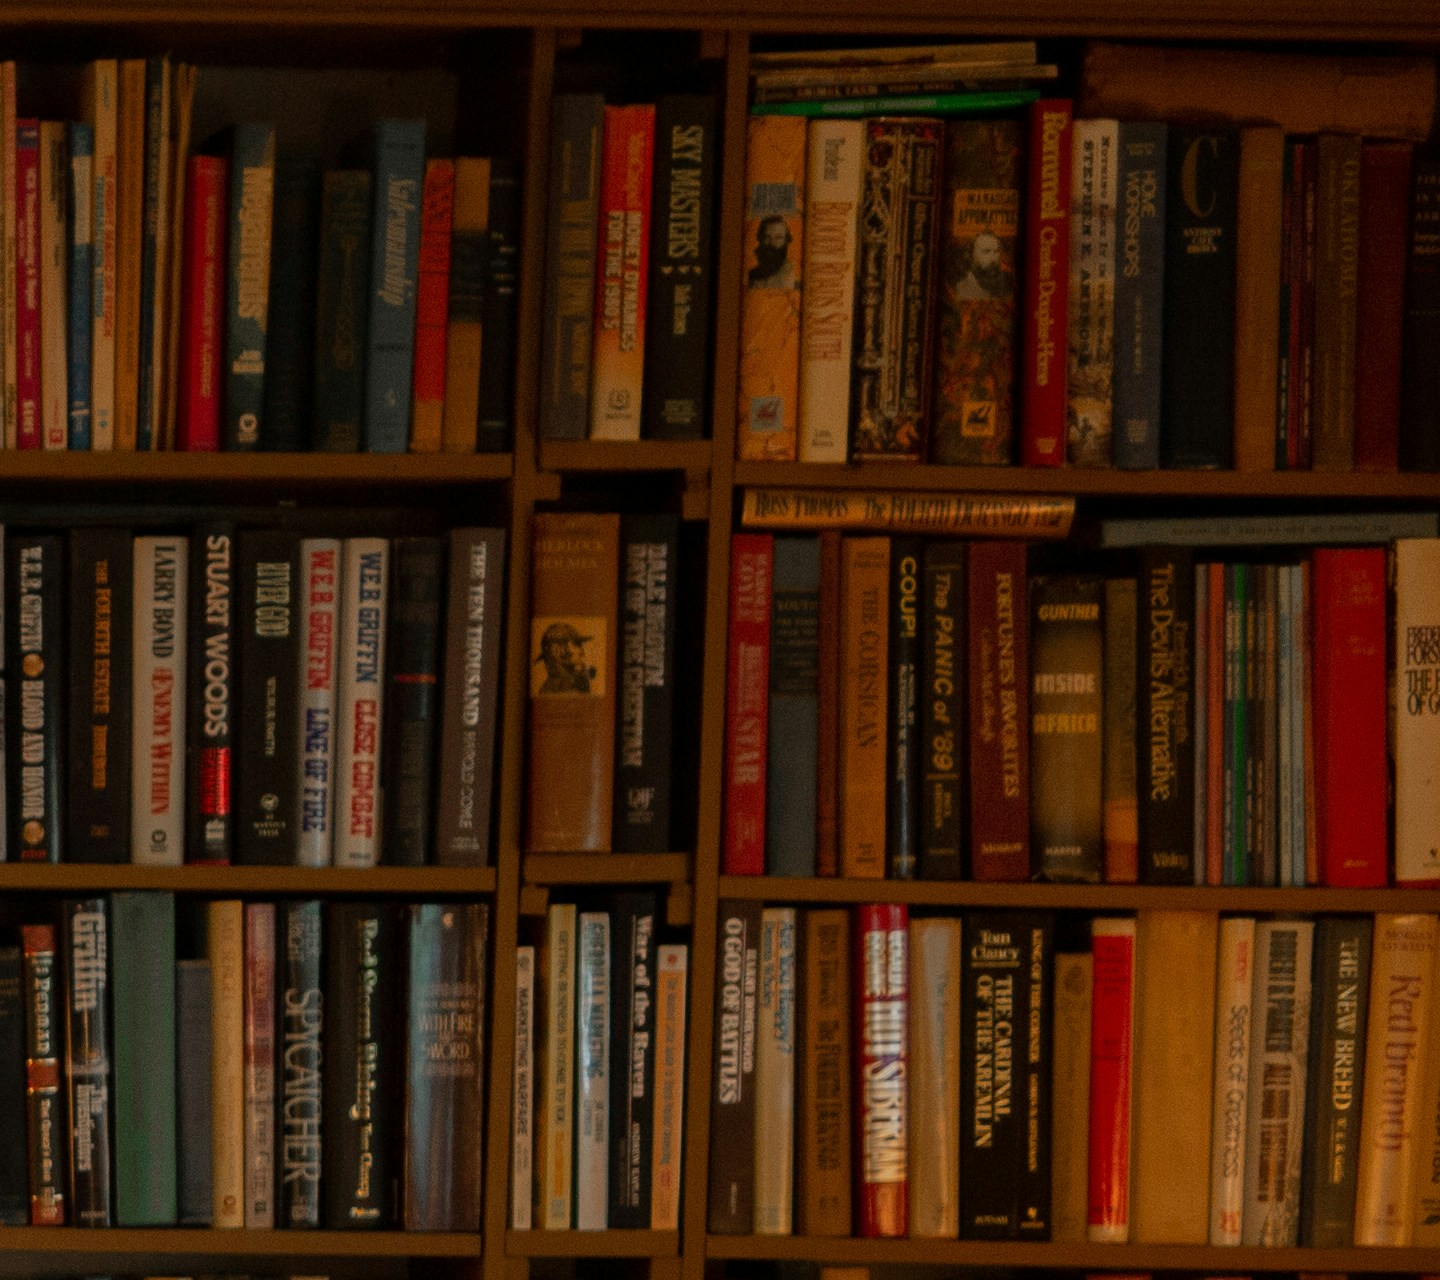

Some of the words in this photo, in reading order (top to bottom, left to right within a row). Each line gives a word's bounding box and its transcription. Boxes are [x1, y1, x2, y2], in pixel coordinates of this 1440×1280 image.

[153, 546, 175, 603] LARRY
[205, 536, 230, 627] STUART
[897, 556, 917, 637] COUP!
[1156, 563, 1174, 605] The
[153, 609, 174, 658] BOND
[1038, 603, 1100, 621] GUNTHER
[203, 632, 230, 738] WOODS
[1034, 674, 1096, 694] INSIDE
[1149, 677, 1174, 801] Alternative
[972, 945, 1019, 962] Clancy
[979, 975, 994, 998] OF
[999, 975, 1013, 1004] THE
[977, 1008, 992, 1048] THE
[284, 988, 323, 1183] SPYCATCHER
[995, 1008, 1012, 1123] CARDINAL
[975, 1059, 992, 1147] KREMLIN
